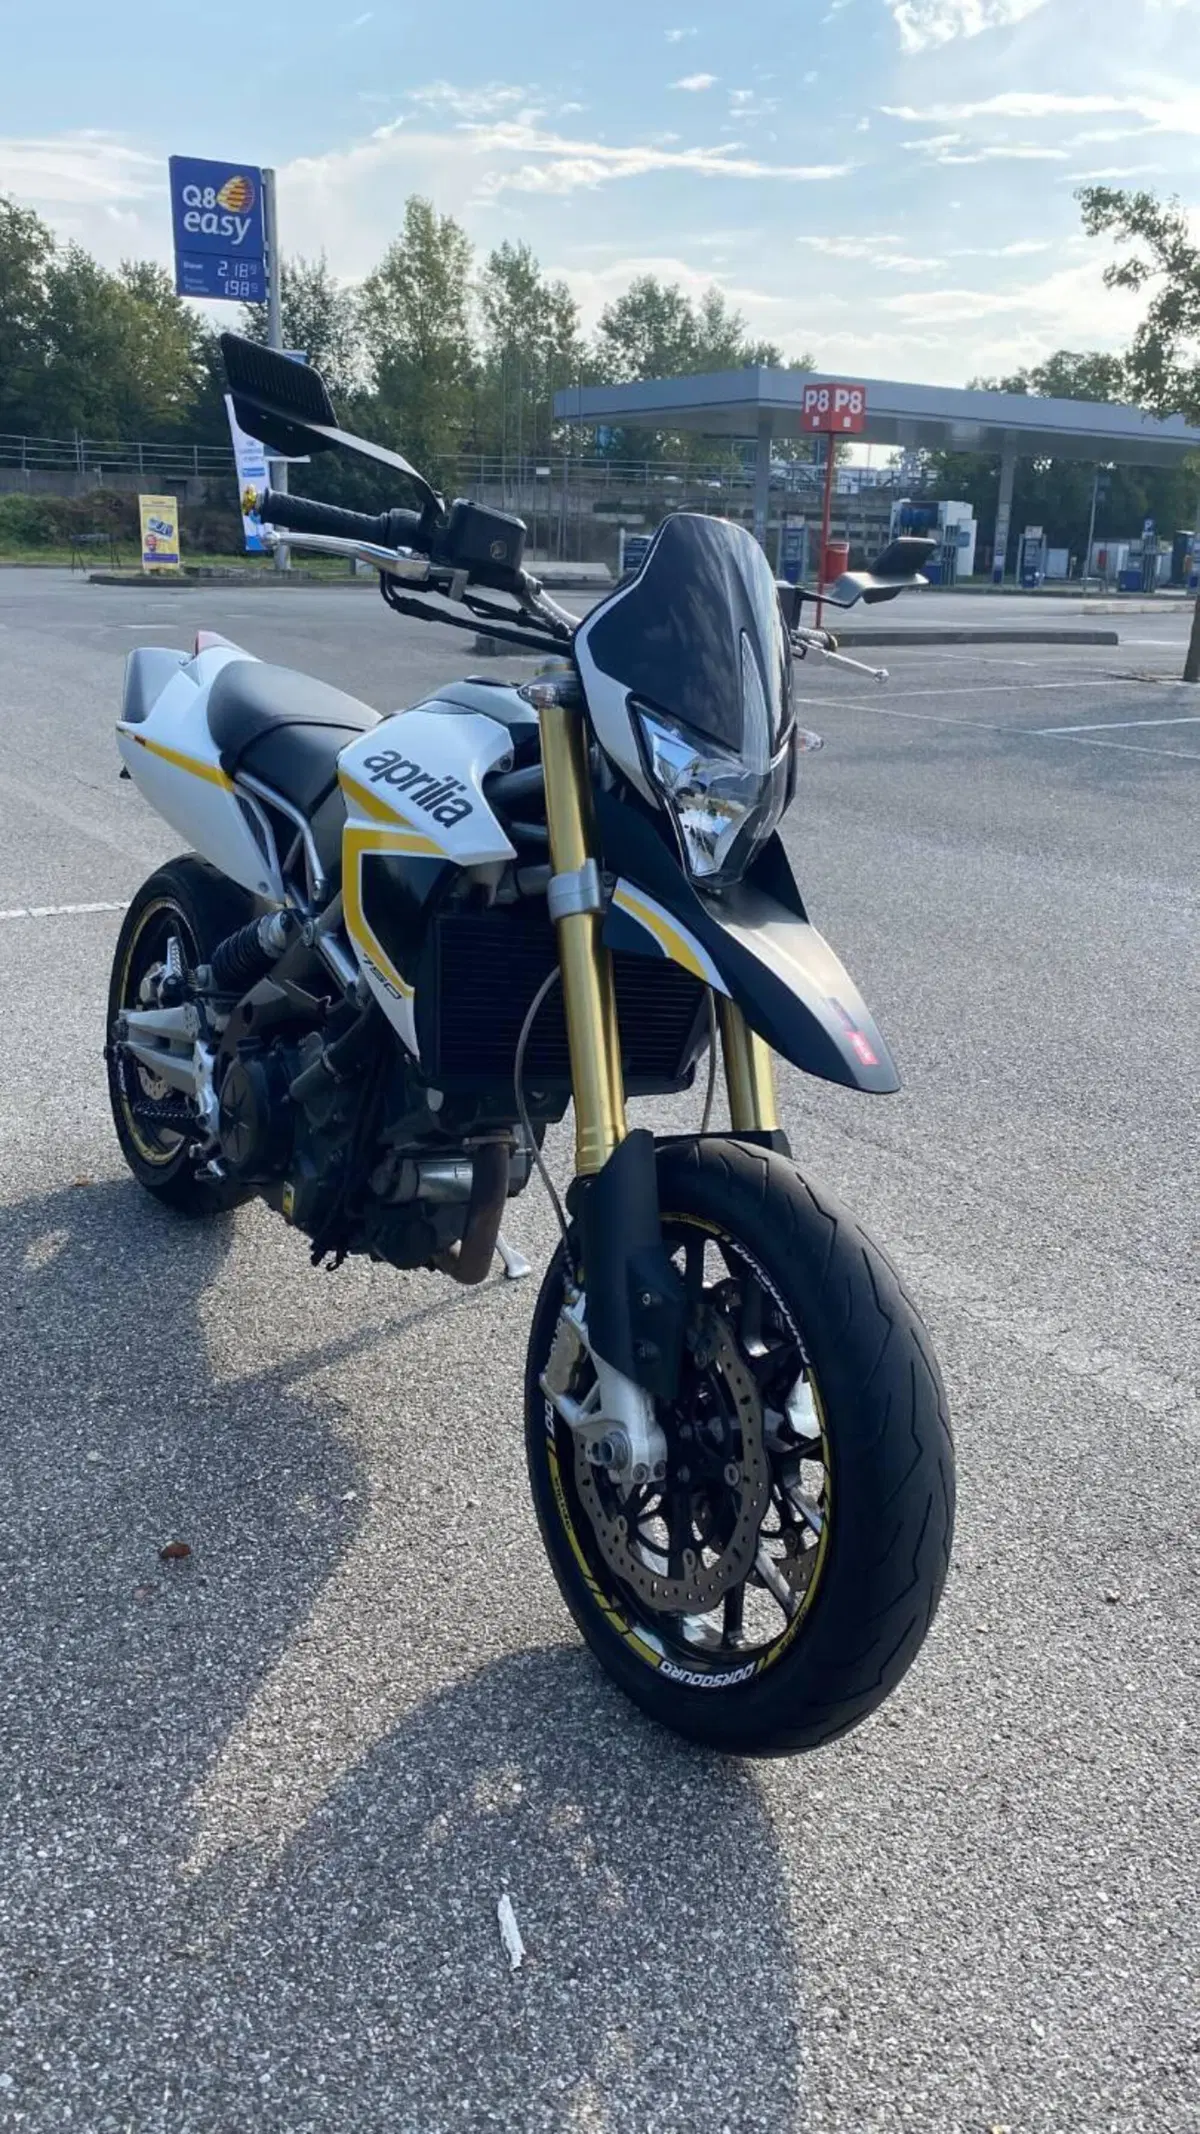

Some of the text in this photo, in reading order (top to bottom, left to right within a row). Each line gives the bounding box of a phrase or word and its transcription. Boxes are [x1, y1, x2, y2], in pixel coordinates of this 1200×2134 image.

[182, 184, 216, 209] Q8
[183, 210, 252, 245] easy
[805, 389, 829, 413] P8
[834, 388, 862, 414] P8
[363, 750, 474, 829] aprilia
[660, 1660, 756, 1687] DORSODURO
